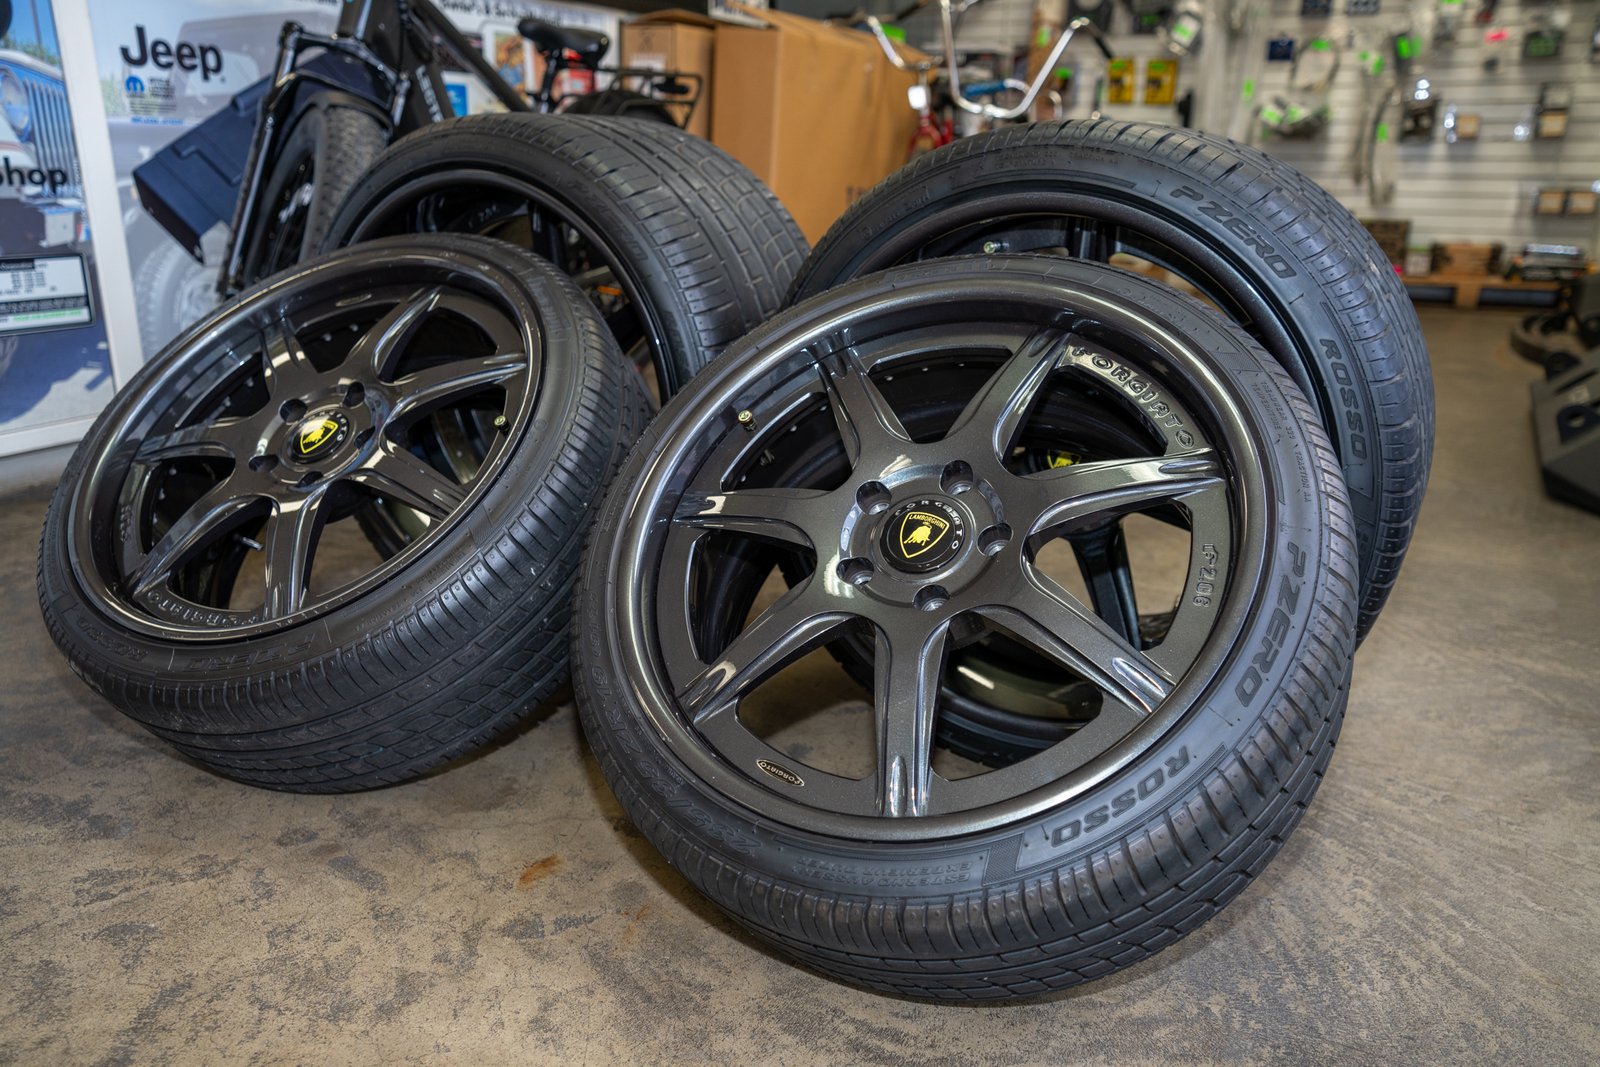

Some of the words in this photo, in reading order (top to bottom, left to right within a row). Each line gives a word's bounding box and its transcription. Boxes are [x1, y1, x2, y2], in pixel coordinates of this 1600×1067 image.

[120, 24, 223, 82] Jeep
[0, 156, 67, 194] hop
[1169, 184, 1204, 201] P
[1198, 200, 1298, 280] ZERO
[1071, 346, 1195, 449] FORGIATO
[1318, 337, 1368, 460] ROSSO
[908, 513, 946, 530] LAMBORGHINI
[1287, 541, 1307, 577] P
[1234, 574, 1301, 708] ZERO
[759, 761, 801, 785] FORGIATO
[1050, 745, 1191, 849] ROSSO
